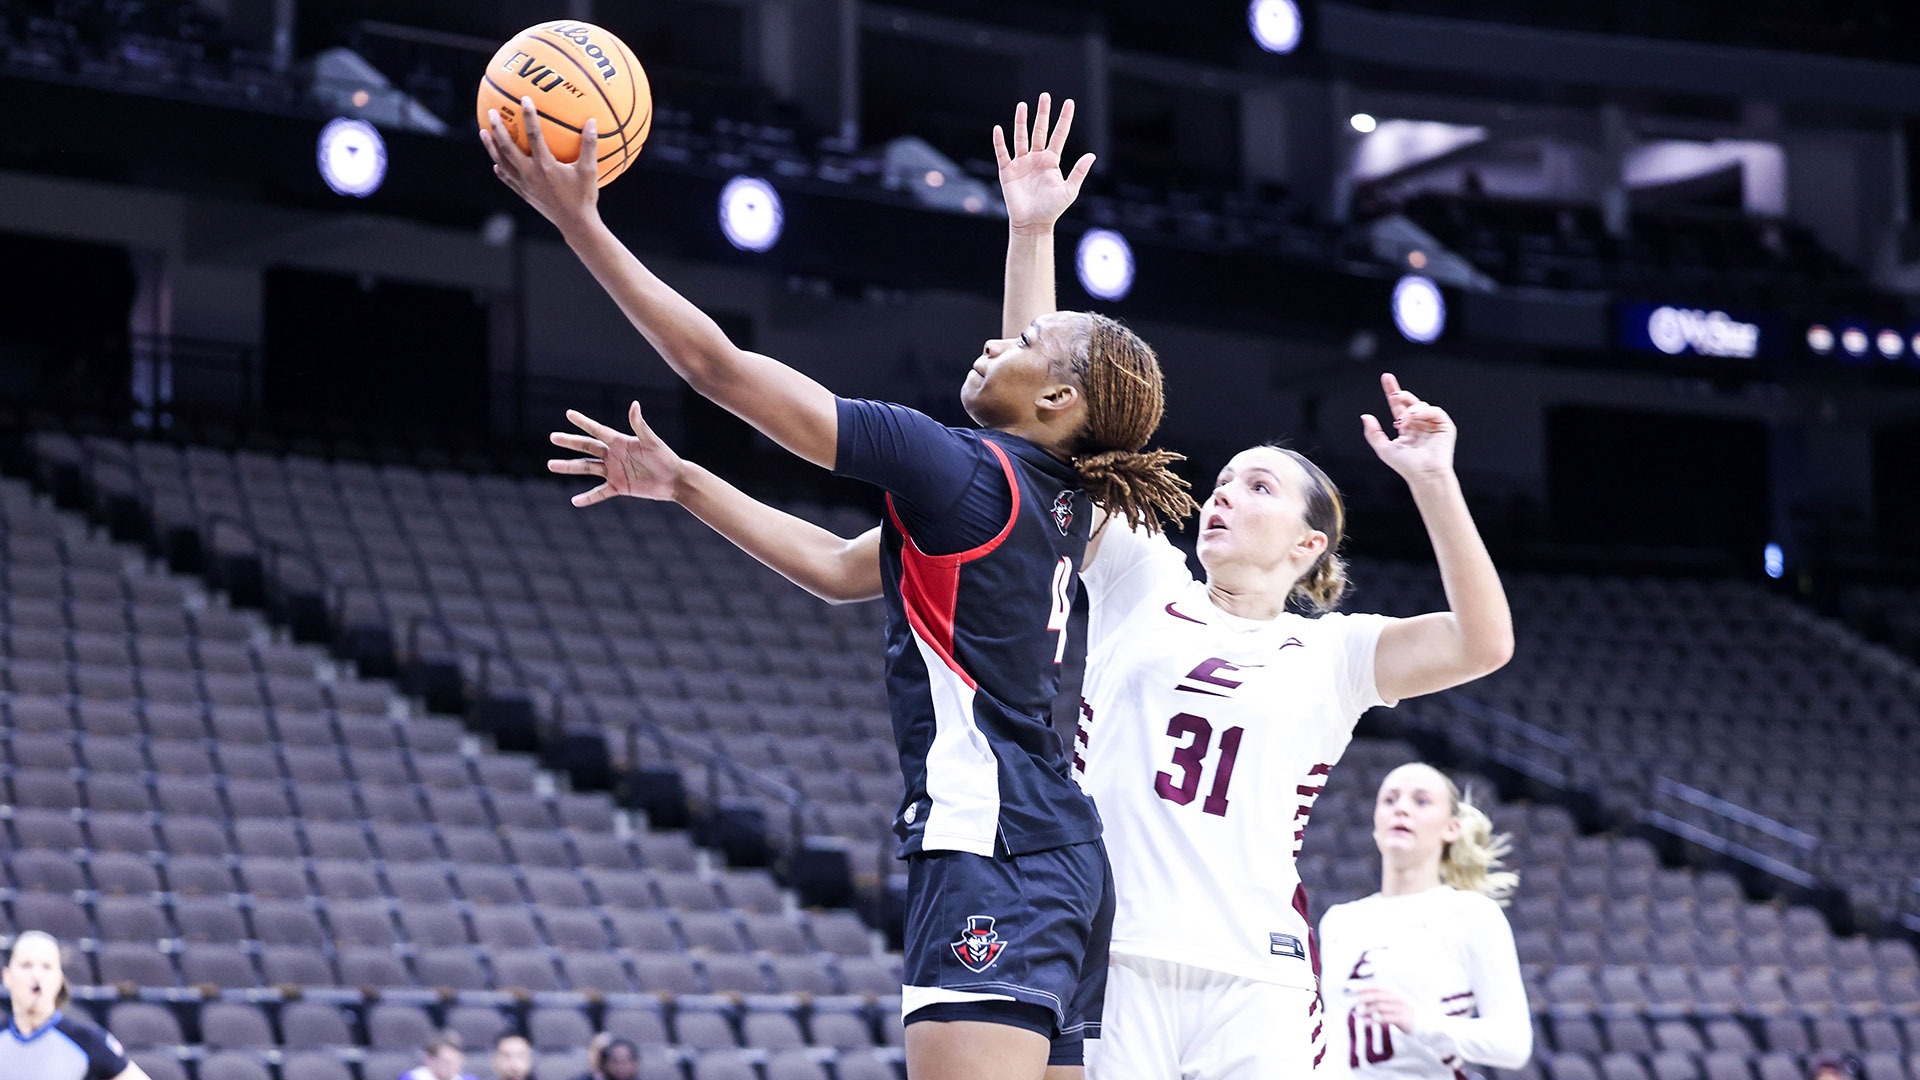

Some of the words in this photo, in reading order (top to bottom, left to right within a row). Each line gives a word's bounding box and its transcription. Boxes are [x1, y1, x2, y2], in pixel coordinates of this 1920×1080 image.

[503, 50, 564, 92] EVO
[1046, 555, 1073, 664] 4
[1154, 712, 1244, 818] 31
[1347, 1007, 1395, 1069] 10
